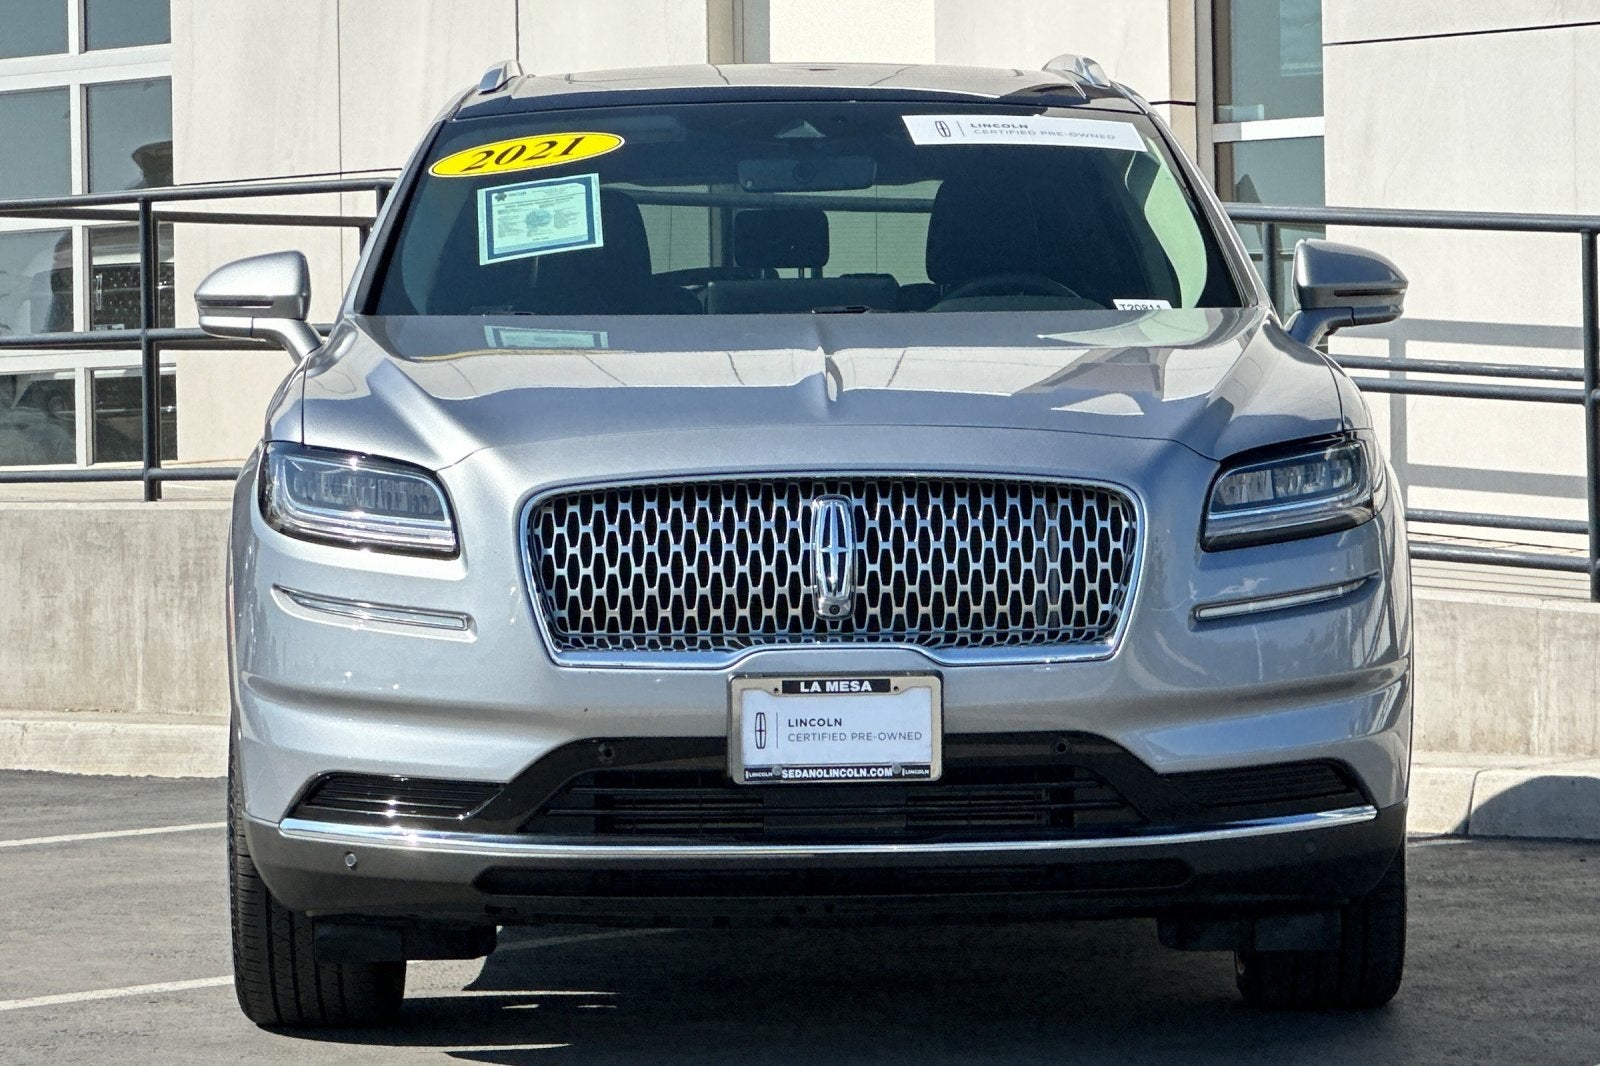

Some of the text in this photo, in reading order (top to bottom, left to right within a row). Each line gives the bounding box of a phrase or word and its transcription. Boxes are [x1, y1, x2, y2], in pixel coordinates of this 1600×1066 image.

[1040, 130, 1116, 140] PRE-OWNED
[459, 136, 586, 173] 2021
[800, 680, 872, 693] LA MESA
[788, 718, 842, 727] LINCOLN
[788, 731, 922, 742] CERTIFIED PRE-OWNED
[781, 767, 893, 779] SEDANOLINCOLN.COM
